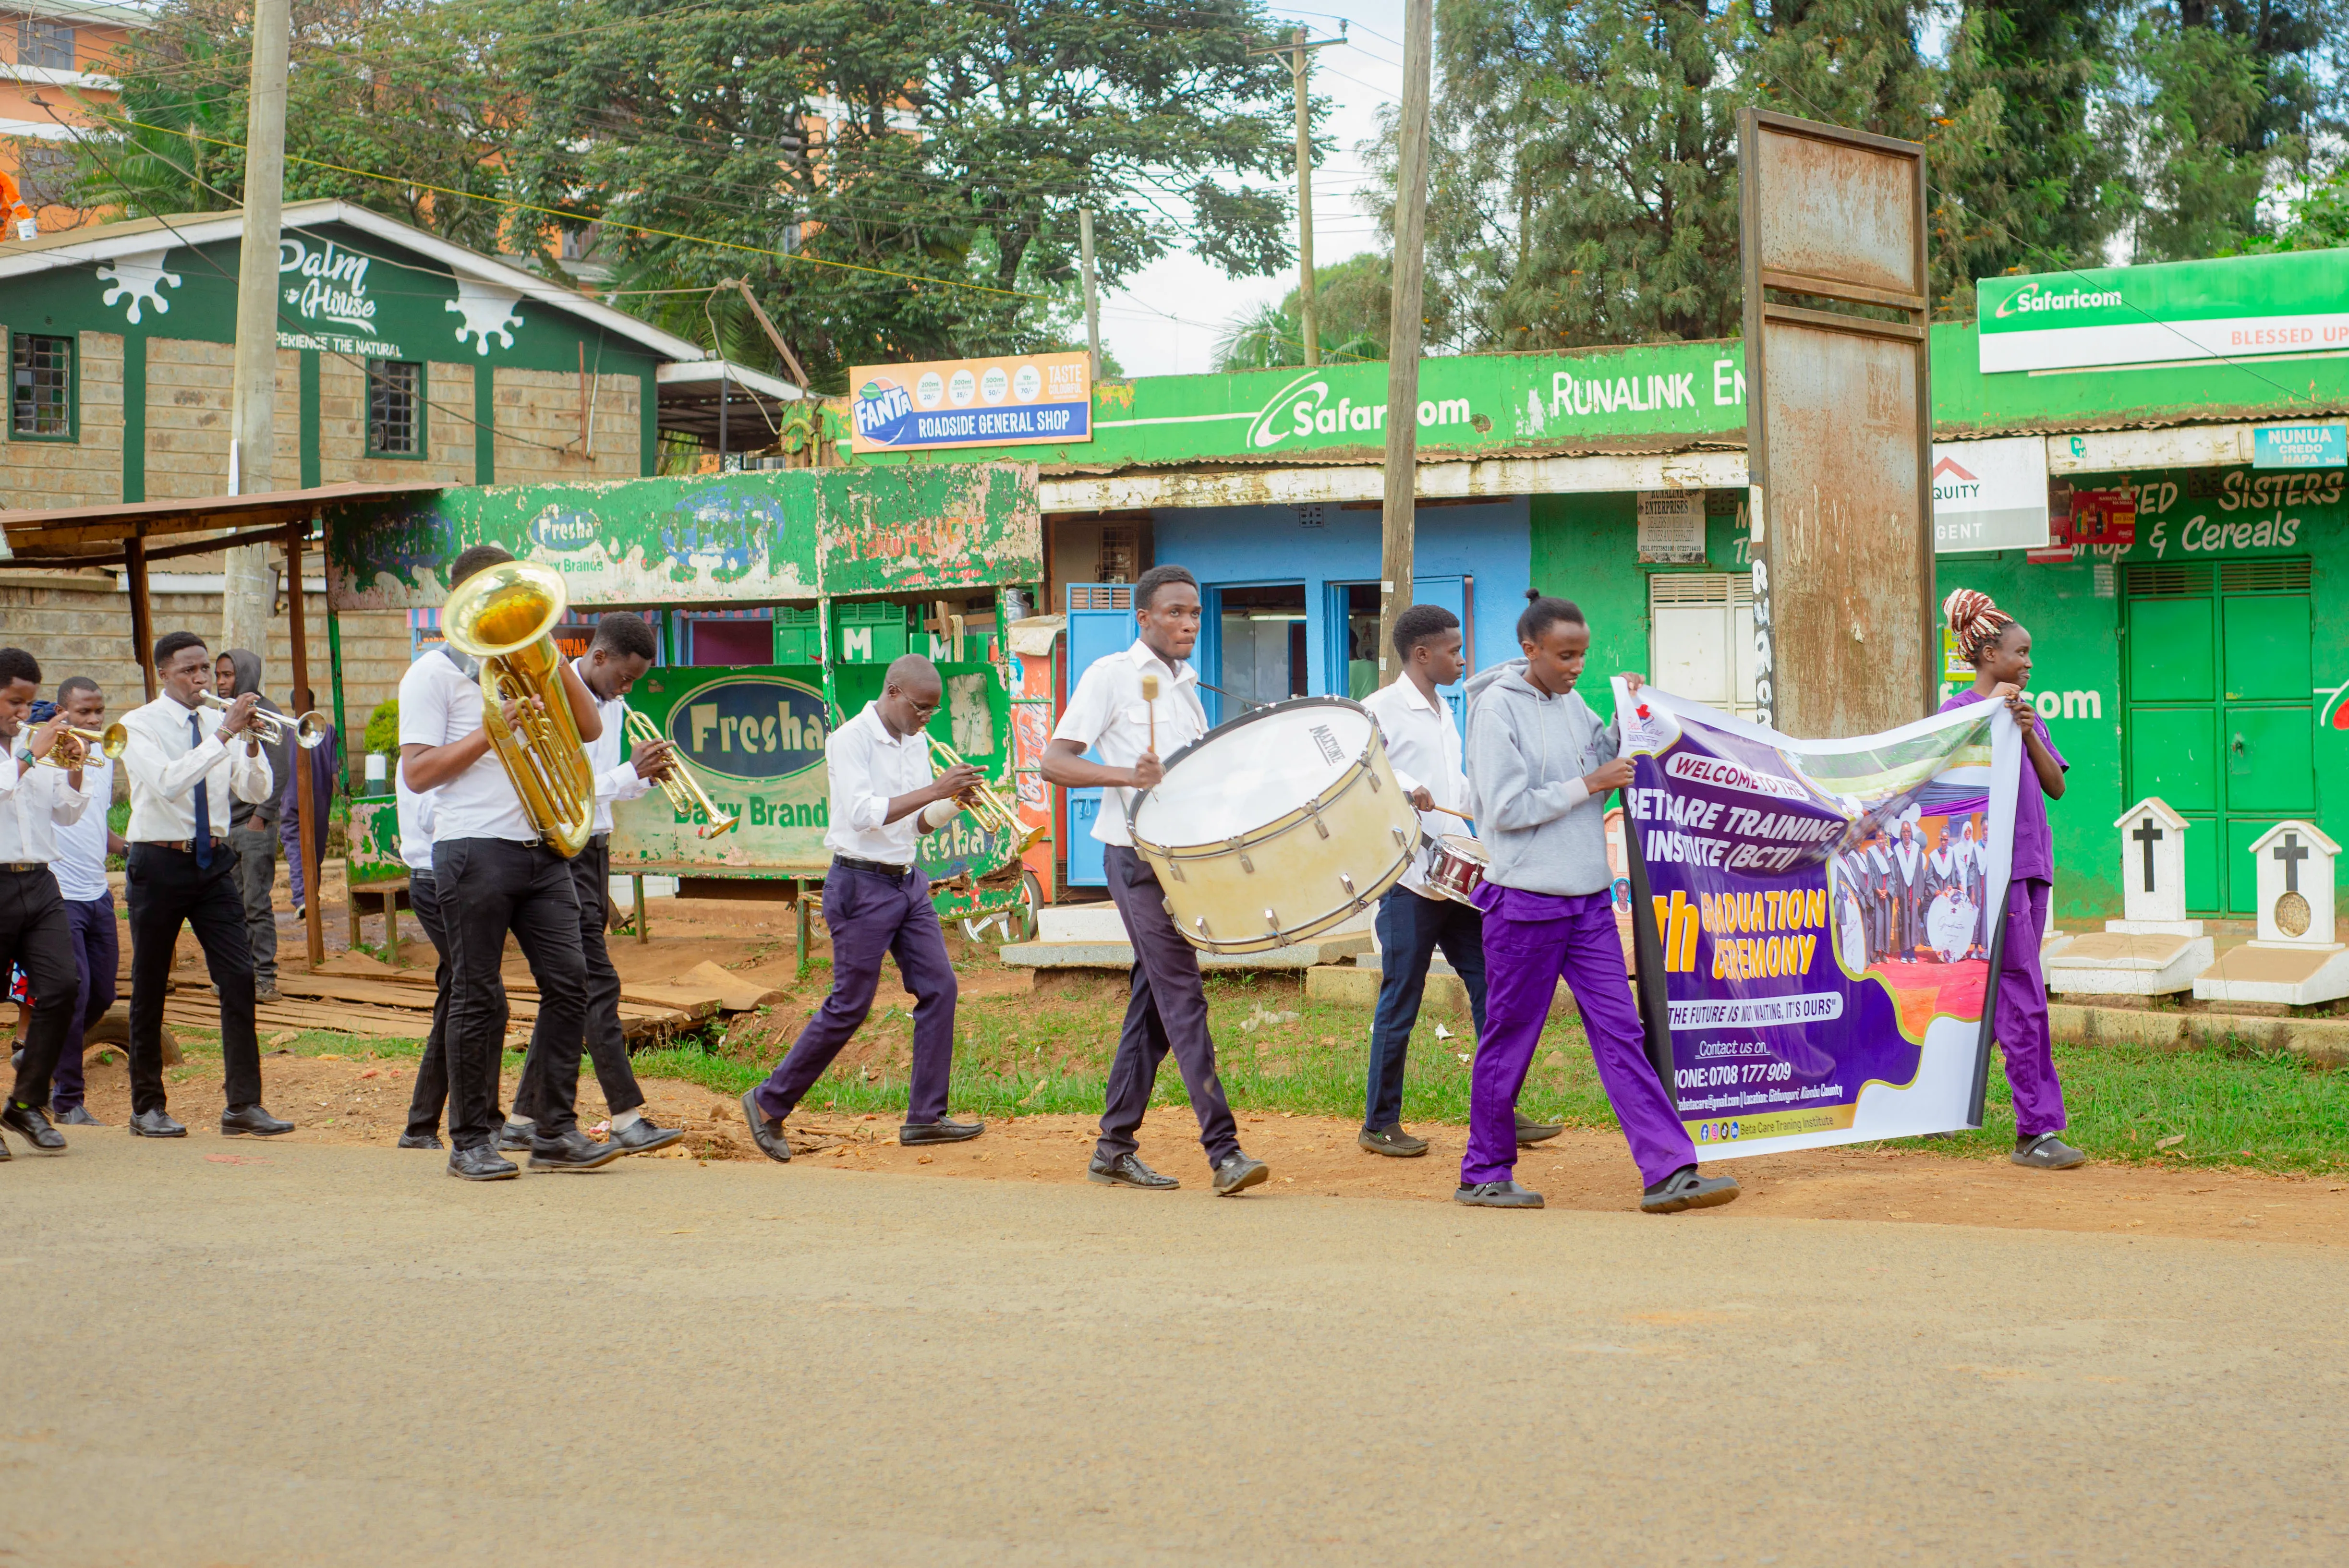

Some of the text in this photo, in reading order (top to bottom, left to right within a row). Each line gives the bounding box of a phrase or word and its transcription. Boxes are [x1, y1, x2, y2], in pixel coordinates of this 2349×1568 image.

[301, 278, 376, 319] House
[2018, 288, 2122, 312] Safaricom
[276, 332, 403, 358] PERIENCE THE NATURAL
[2232, 327, 2313, 345] BLESSED
[1048, 364, 1082, 384] TASTE
[1048, 383, 1082, 395] COLOURFUL
[1553, 372, 1695, 416] RUNALINK
[854, 387, 912, 434] FANTA
[1293, 398, 1470, 437] Safarom
[918, 410, 1070, 438] ROADSIDE GENERAL SHOP
[2268, 428, 2332, 445] NUNUA
[2279, 444, 2323, 454] CREDO
[2282, 454, 2319, 464] HAPA
[1933, 484, 1980, 500] QUITY
[2218, 470, 2344, 511] SISTERS
[1645, 500, 1689, 515] ENTERPRISES
[1936, 522, 1983, 540] GENT
[2182, 510, 2301, 551] Cereals
[690, 700, 825, 754] Fresha
[1308, 724, 1346, 764] MAXTONE
[1675, 756, 1804, 797] WELCOME TO THE
[749, 796, 830, 828] Brand
[1723, 807, 1844, 842] TRAINING
[1724, 842, 1803, 873] (BCTI)
[1690, 1006, 1727, 1024] FUTURE
[1727, 1005, 1739, 1023] IS
[1698, 1039, 1768, 1057] Contact us on
[1708, 1064, 1739, 1086] 0708
[1741, 1063, 1768, 1084] 177
[1766, 1061, 1792, 1082] 909
[1820, 1083, 1843, 1098] County
[1740, 1123, 1756, 1135] Beta
[1757, 1121, 1775, 1134] Care
[1802, 1114, 1834, 1128] Institute
